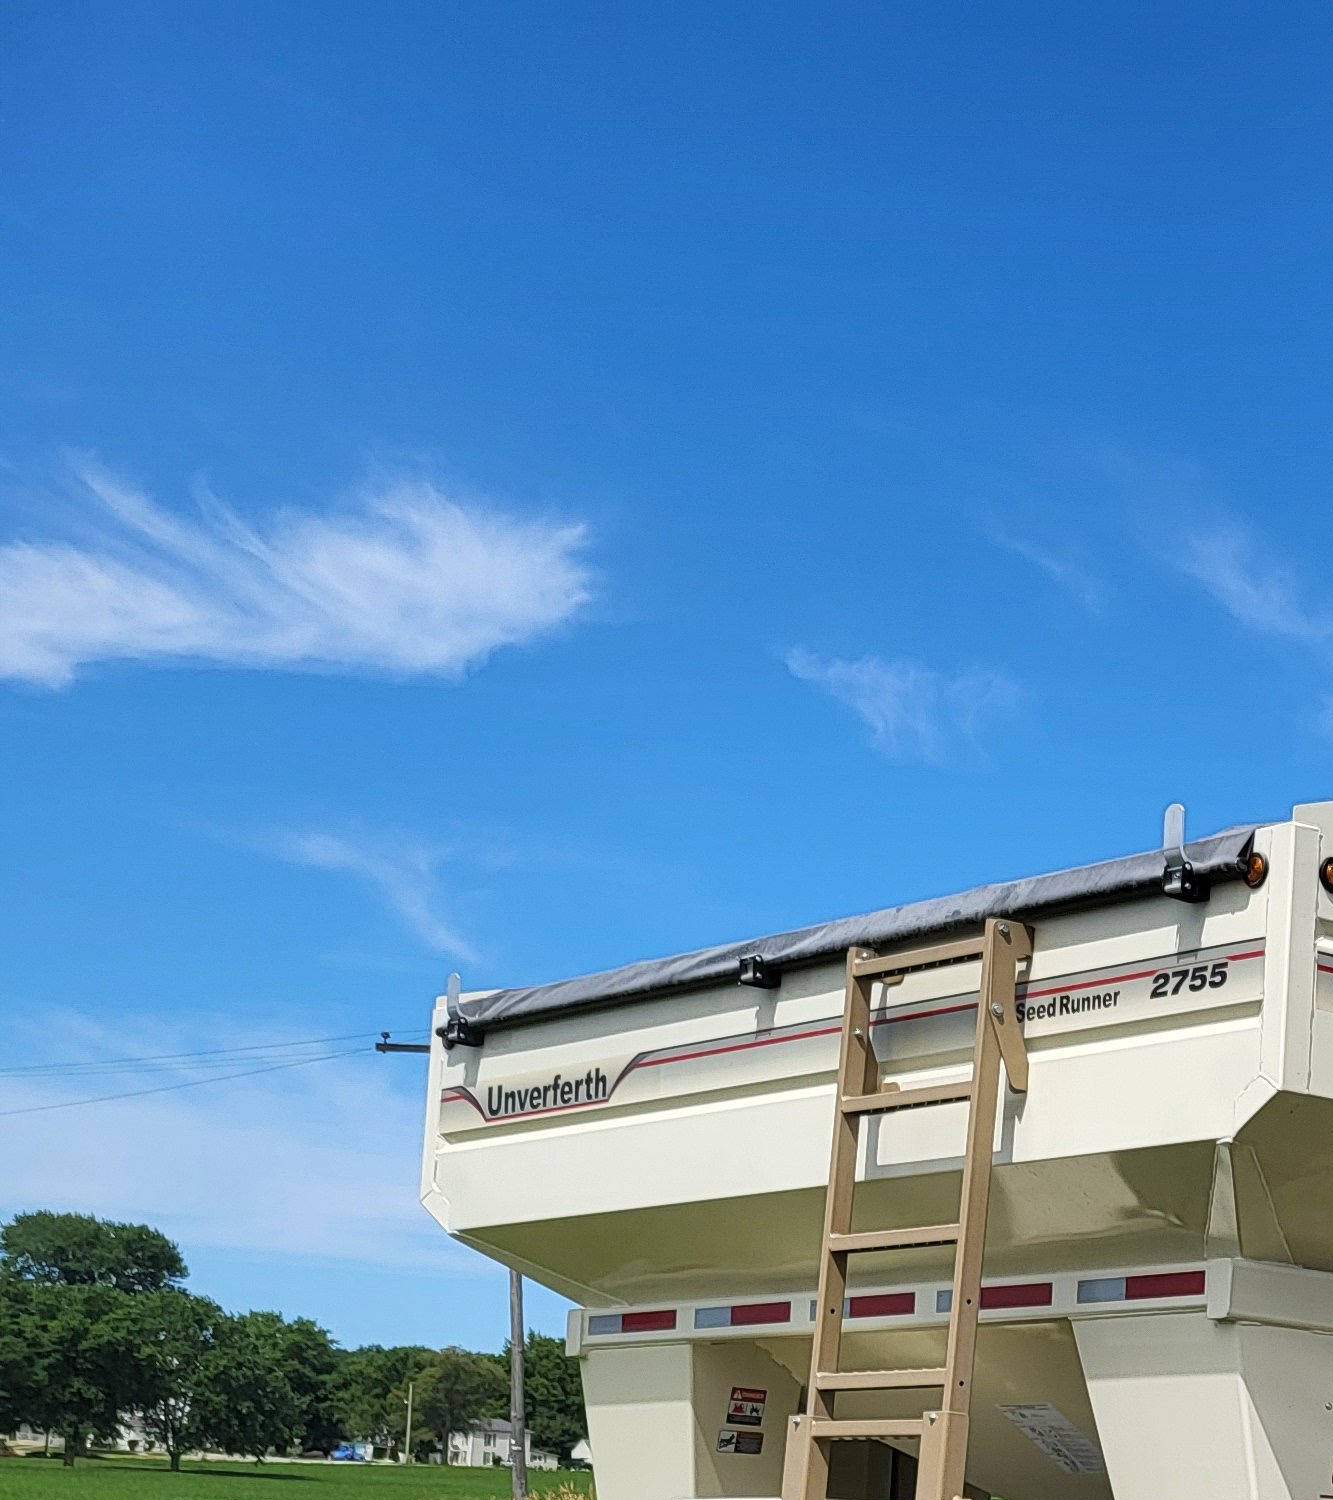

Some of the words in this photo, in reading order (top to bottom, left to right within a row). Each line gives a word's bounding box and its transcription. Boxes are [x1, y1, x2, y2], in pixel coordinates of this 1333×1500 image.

[1016, 997, 1056, 1023] Seed
[1059, 990, 1120, 1015] Runner
[1150, 962, 1229, 999] 2755
[488, 1068, 607, 1116] Unverferth
